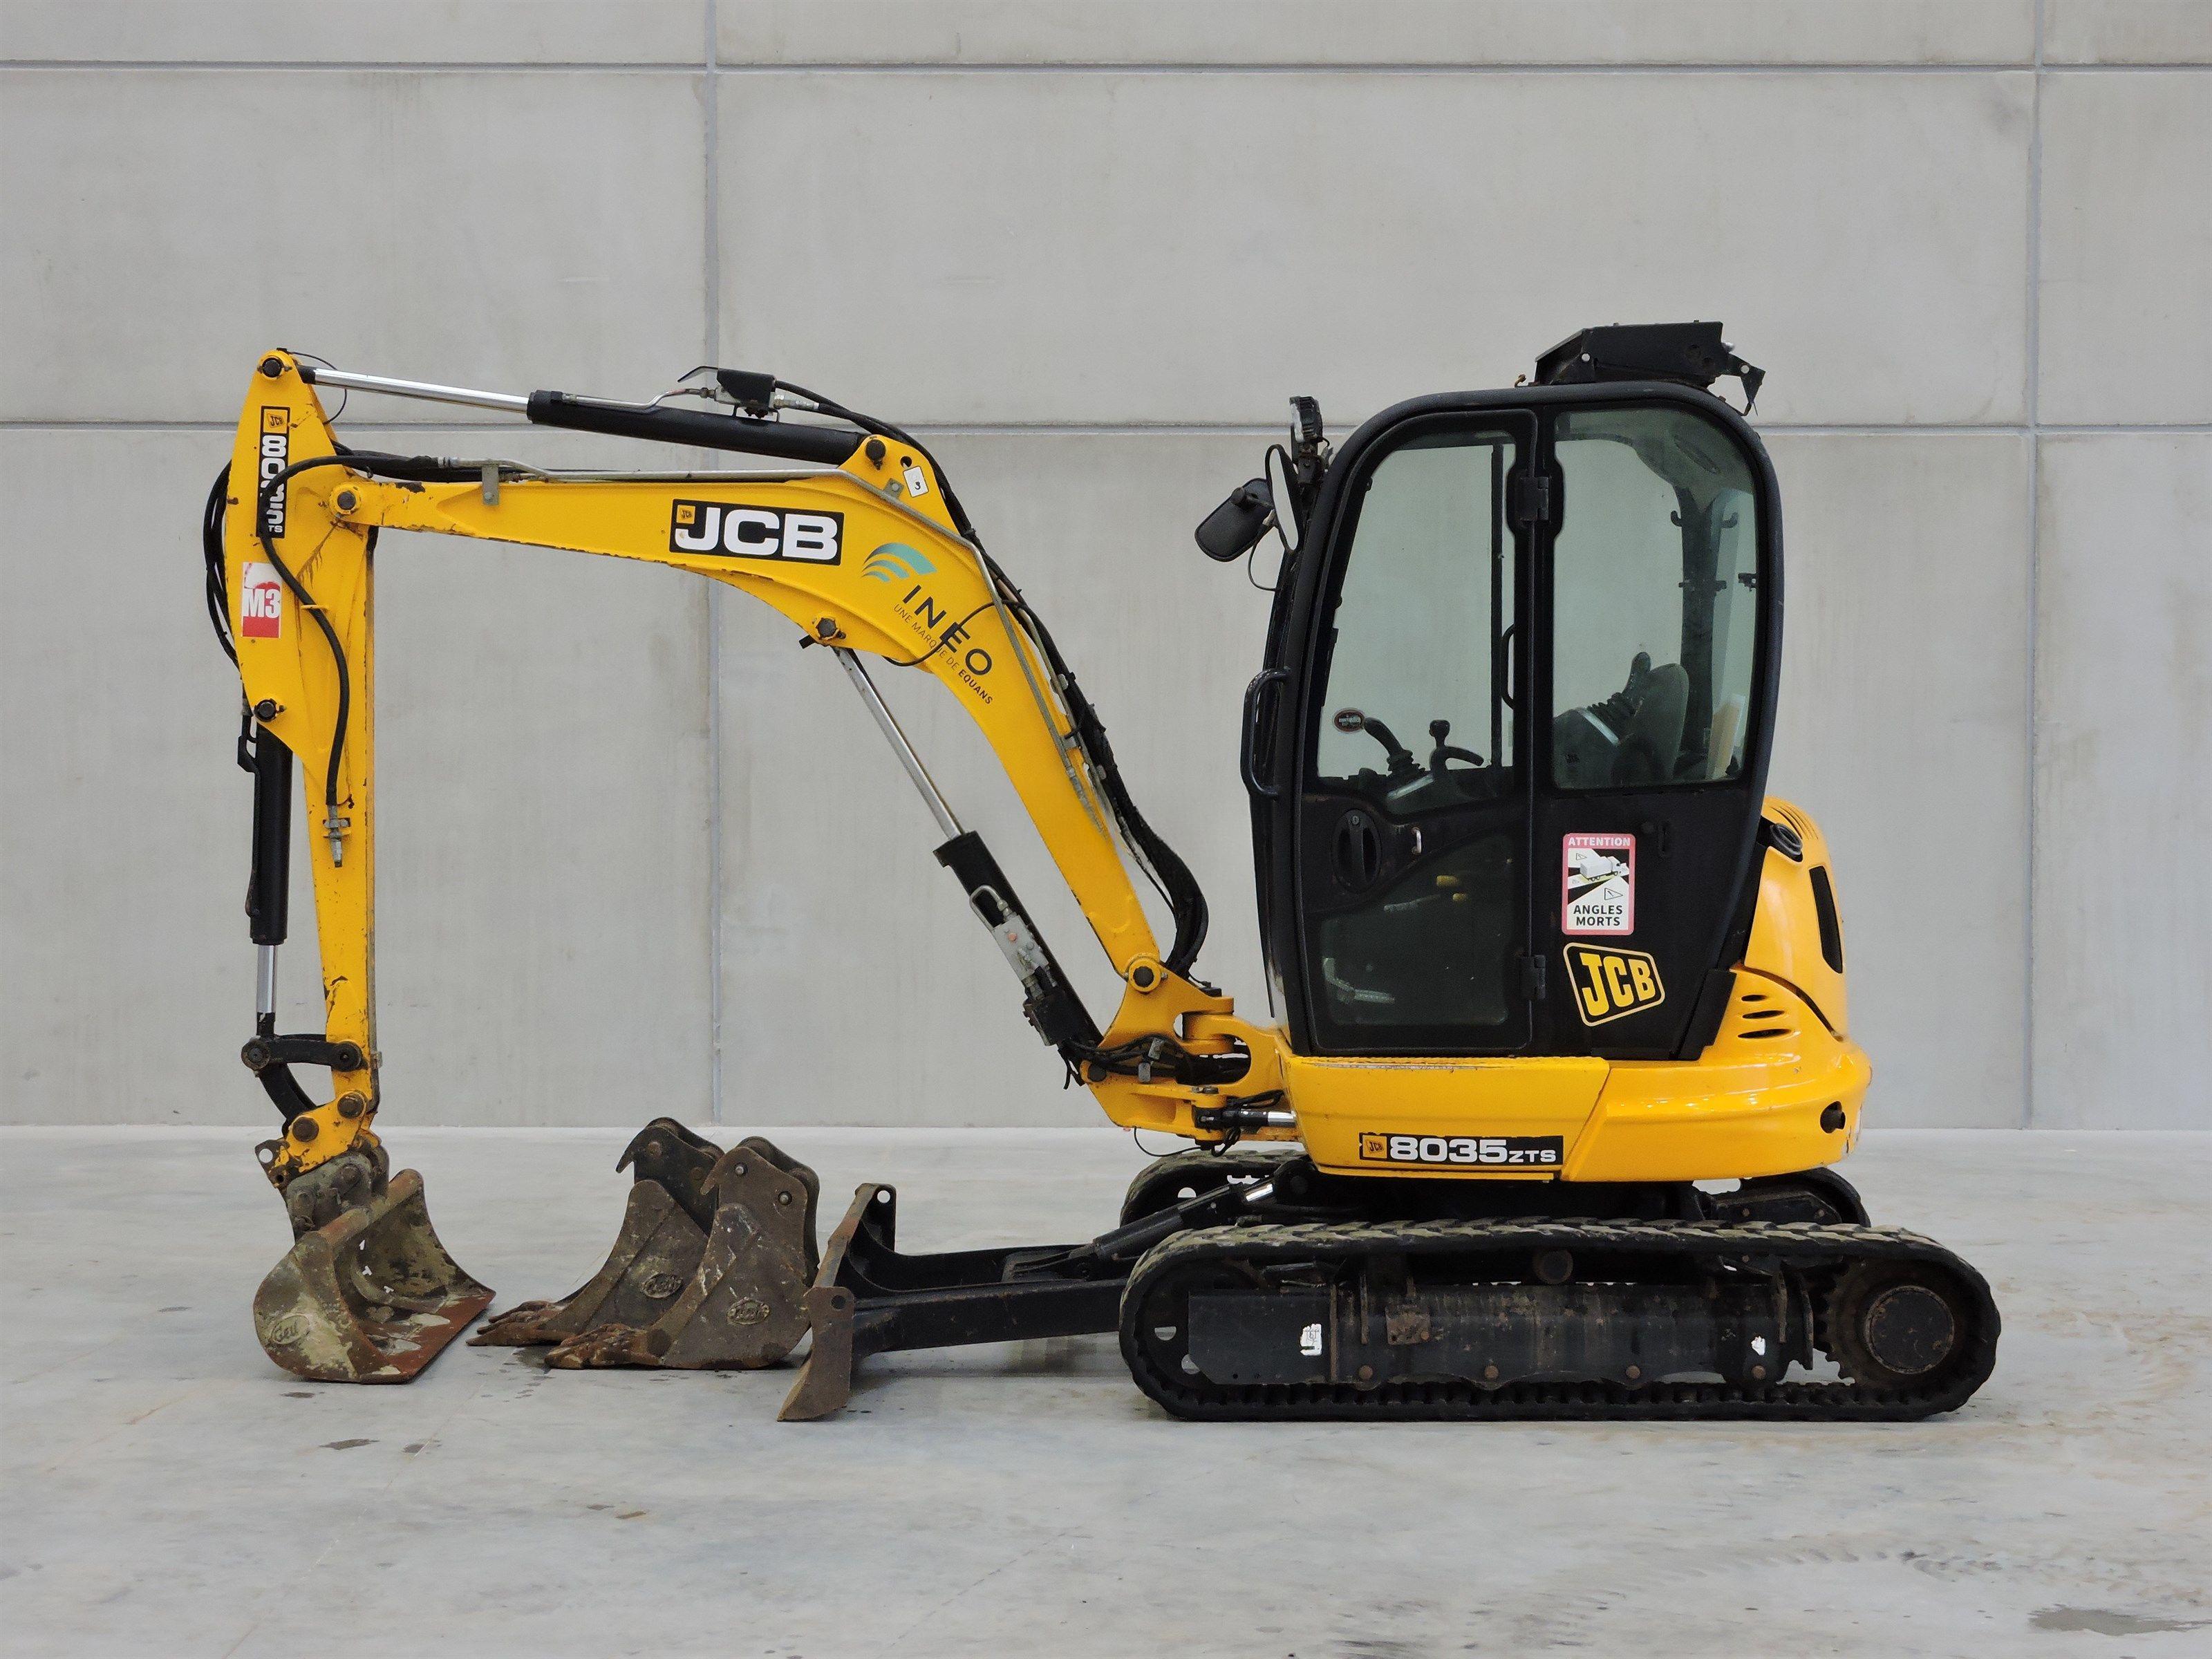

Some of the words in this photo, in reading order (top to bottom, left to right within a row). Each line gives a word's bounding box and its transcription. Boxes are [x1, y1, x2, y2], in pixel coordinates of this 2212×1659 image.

[675, 507, 838, 560] JCB
[243, 588, 281, 619] M3
[902, 584, 993, 676] INEO
[894, 603, 912, 623] UNE
[946, 657, 960, 671] DE
[958, 669, 993, 704] EQUANS
[1568, 837, 1631, 846] ATTENTION
[1573, 905, 1623, 915] ANGLES
[1576, 917, 1620, 926] MORTS
[1579, 952, 1656, 1016] JCB
